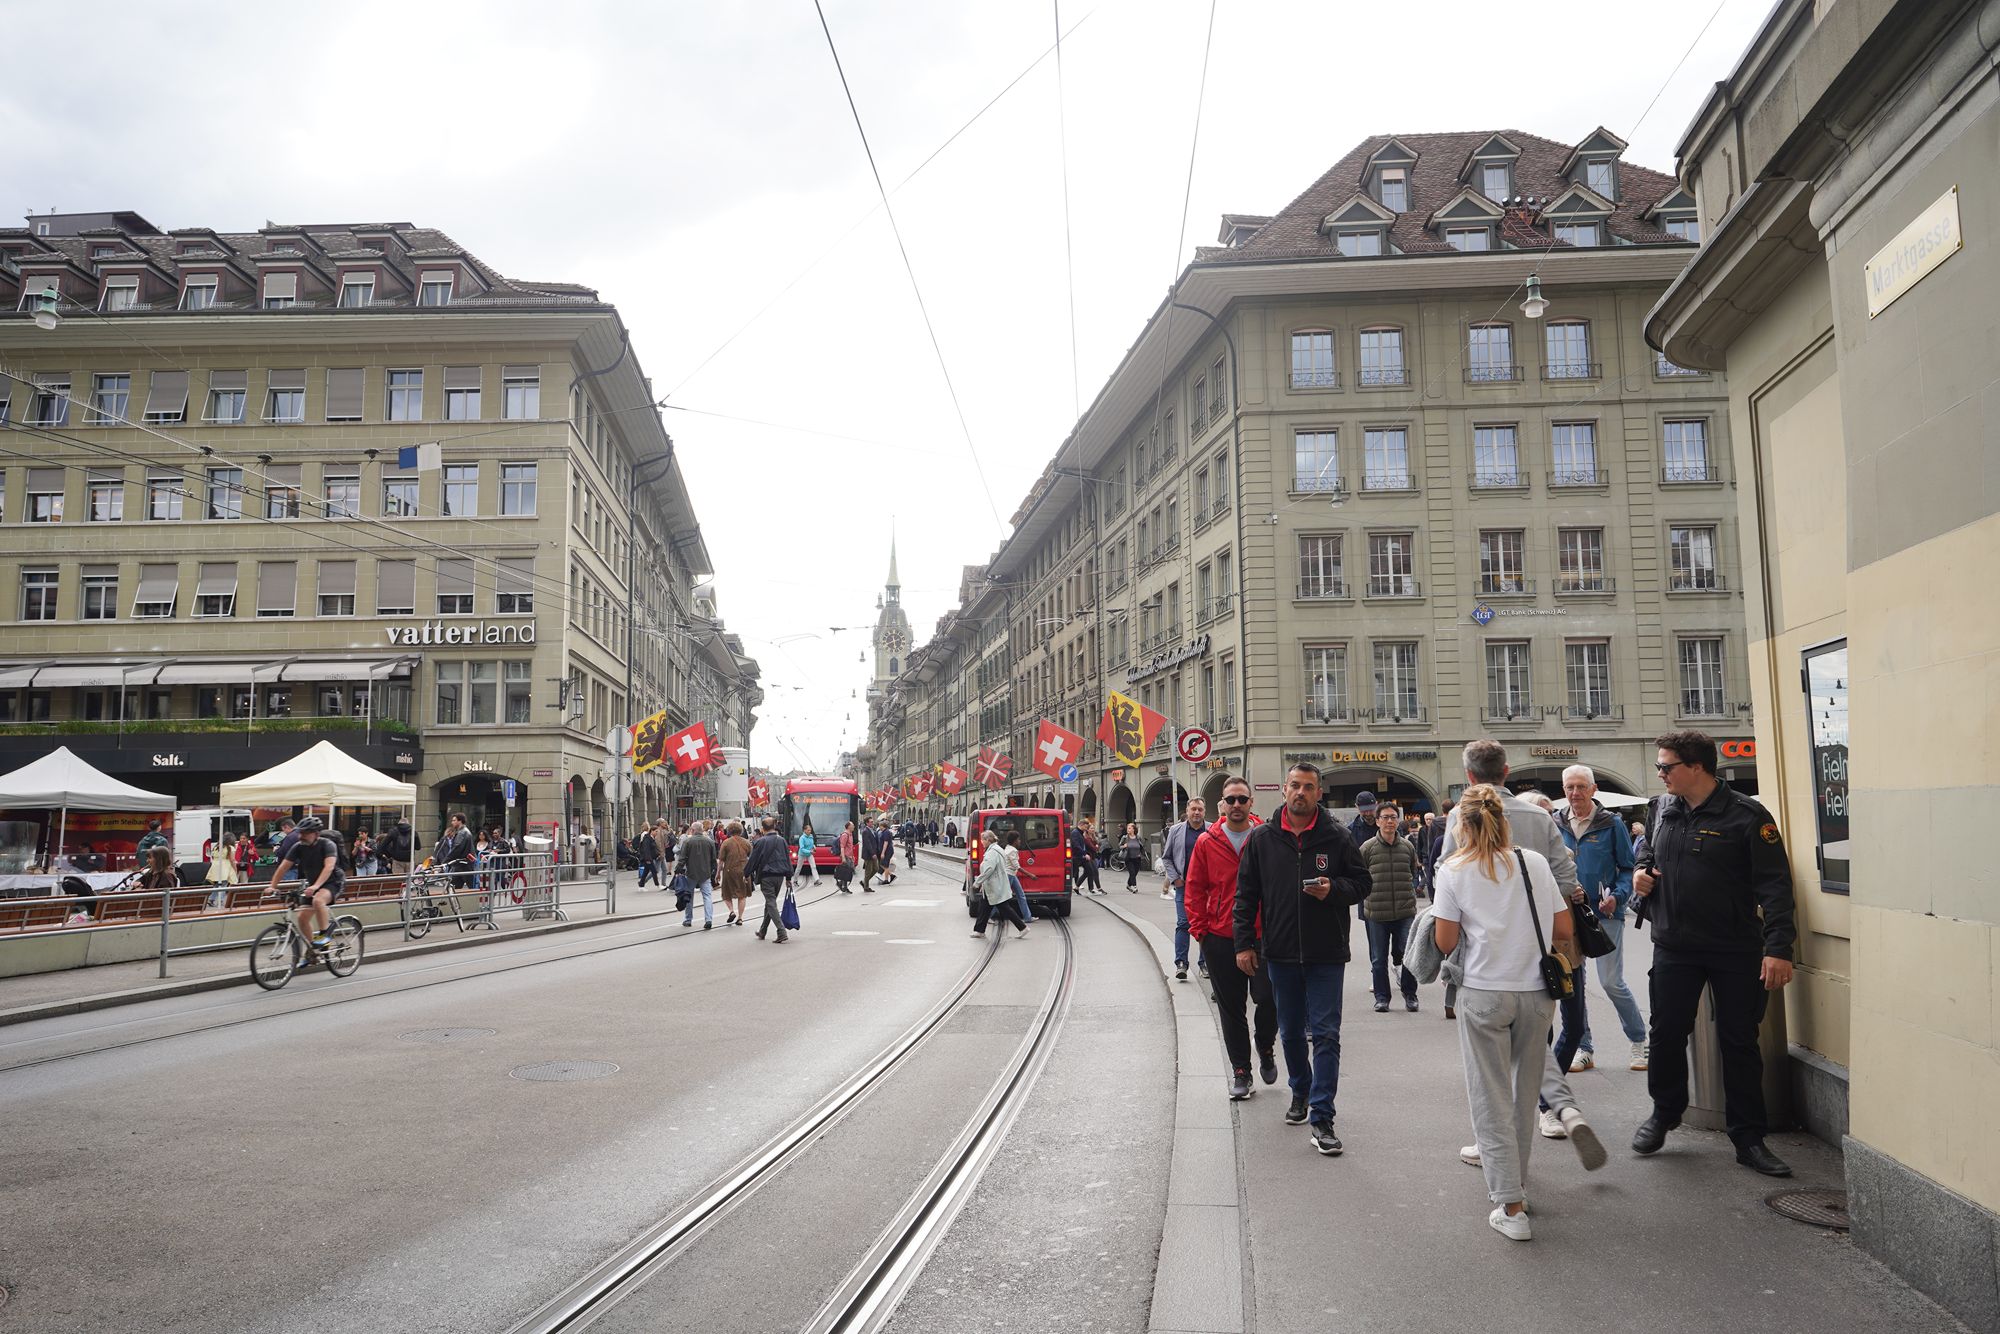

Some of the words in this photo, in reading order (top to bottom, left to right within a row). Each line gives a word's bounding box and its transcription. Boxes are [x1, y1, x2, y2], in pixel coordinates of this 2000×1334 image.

[1872, 217, 1951, 296] Marktgasse
[385, 619, 536, 645] vatterland
[152, 753, 184, 766] Salt.
[1332, 751, 1352, 762] Da
[1355, 750, 1390, 762] Vinci
[463, 760, 493, 772] Salt.
